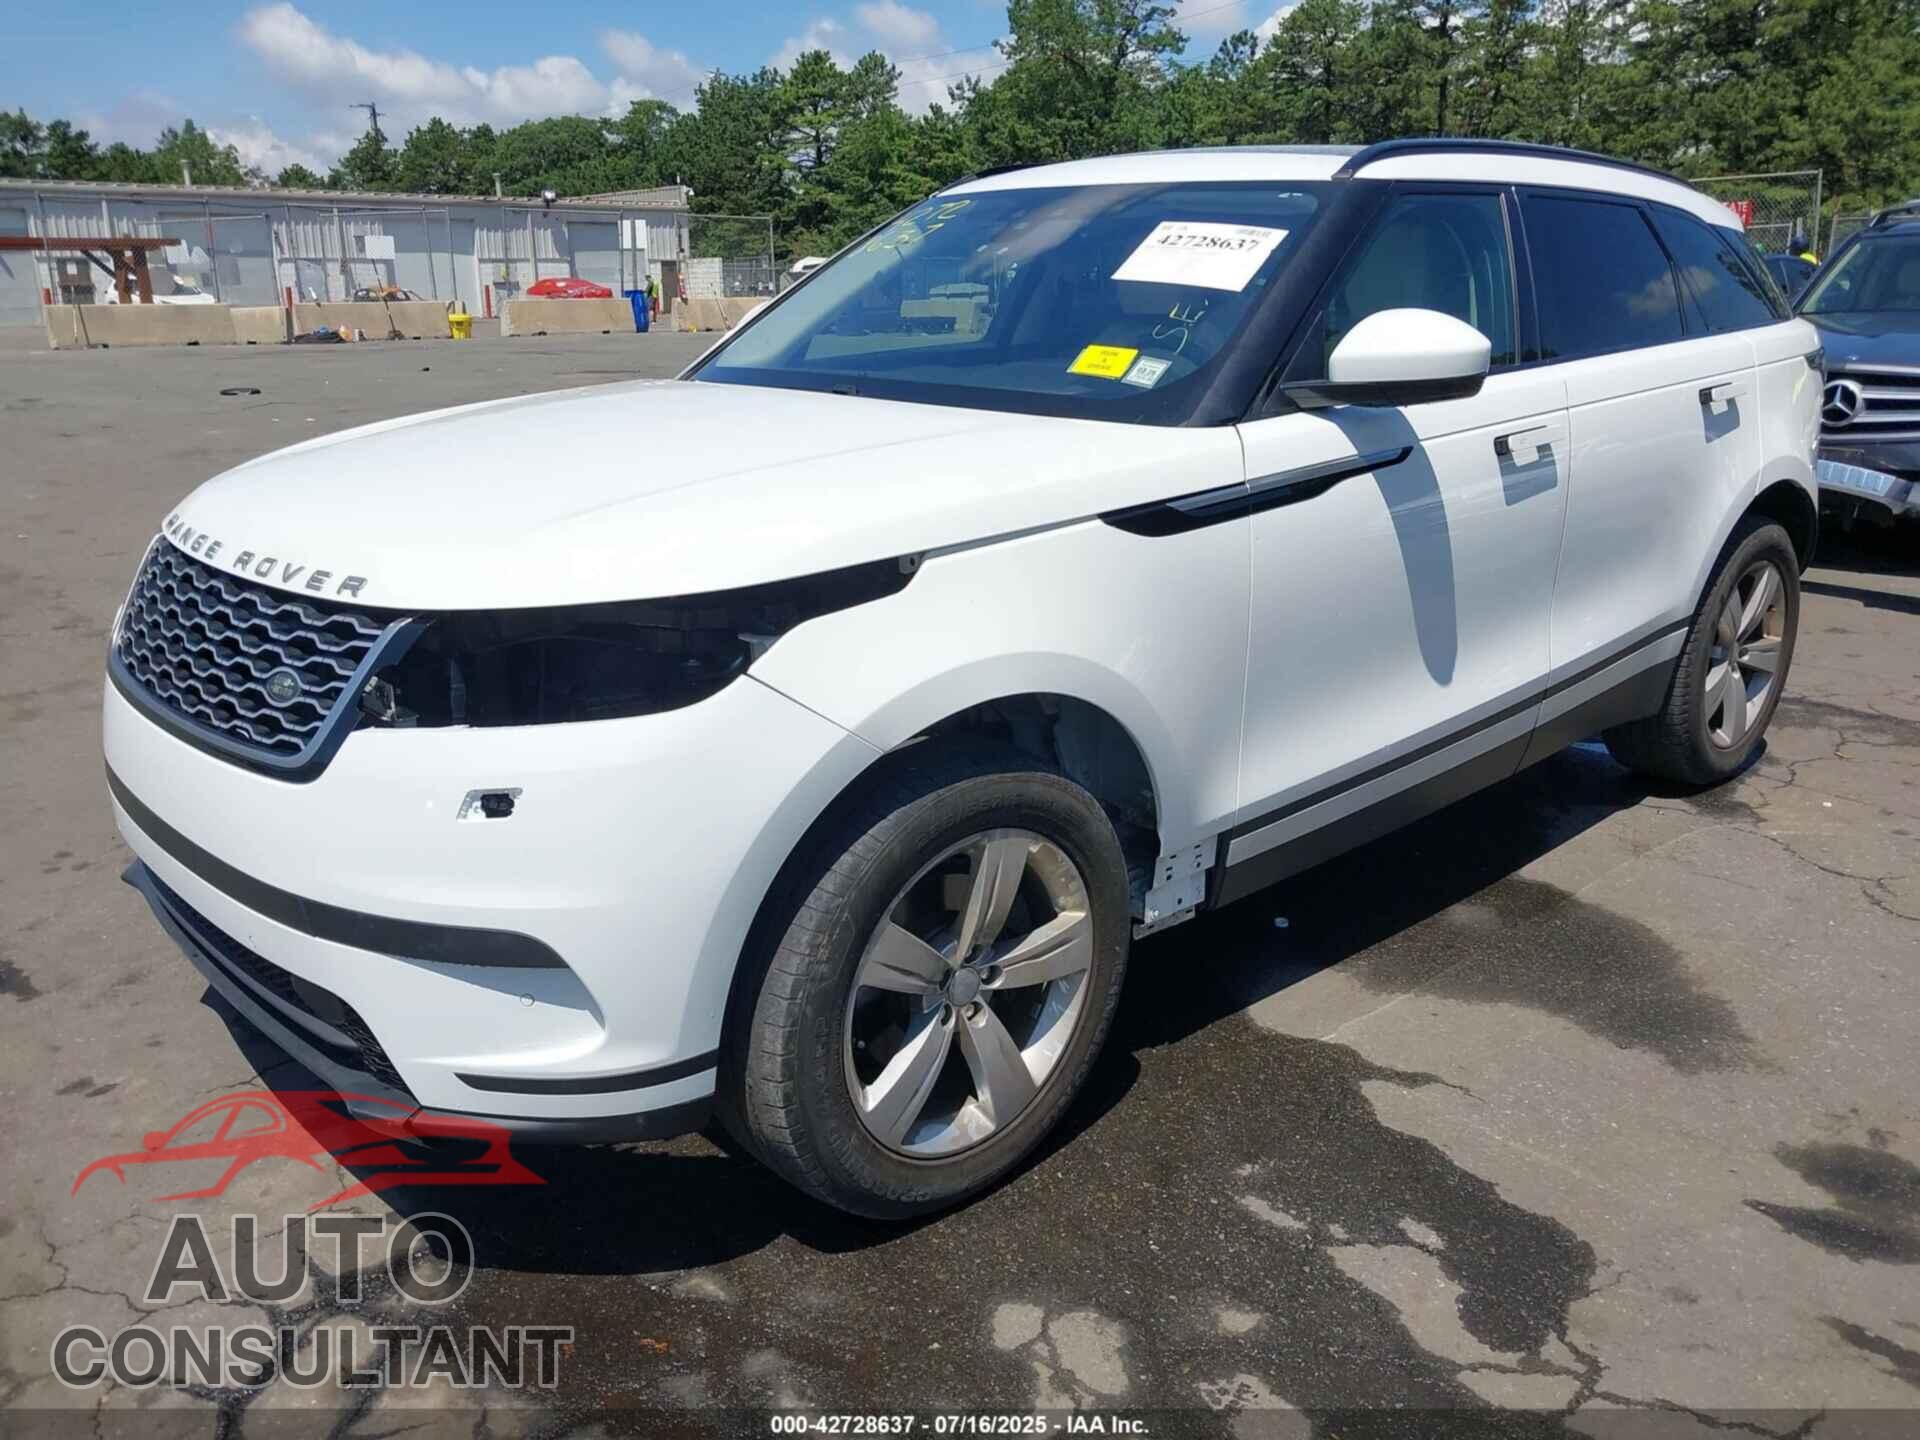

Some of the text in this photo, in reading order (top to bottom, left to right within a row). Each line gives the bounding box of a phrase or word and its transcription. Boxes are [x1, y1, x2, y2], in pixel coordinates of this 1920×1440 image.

[1156, 233, 1261, 252] 42728637
[166, 513, 369, 598] RANGE ROVER
